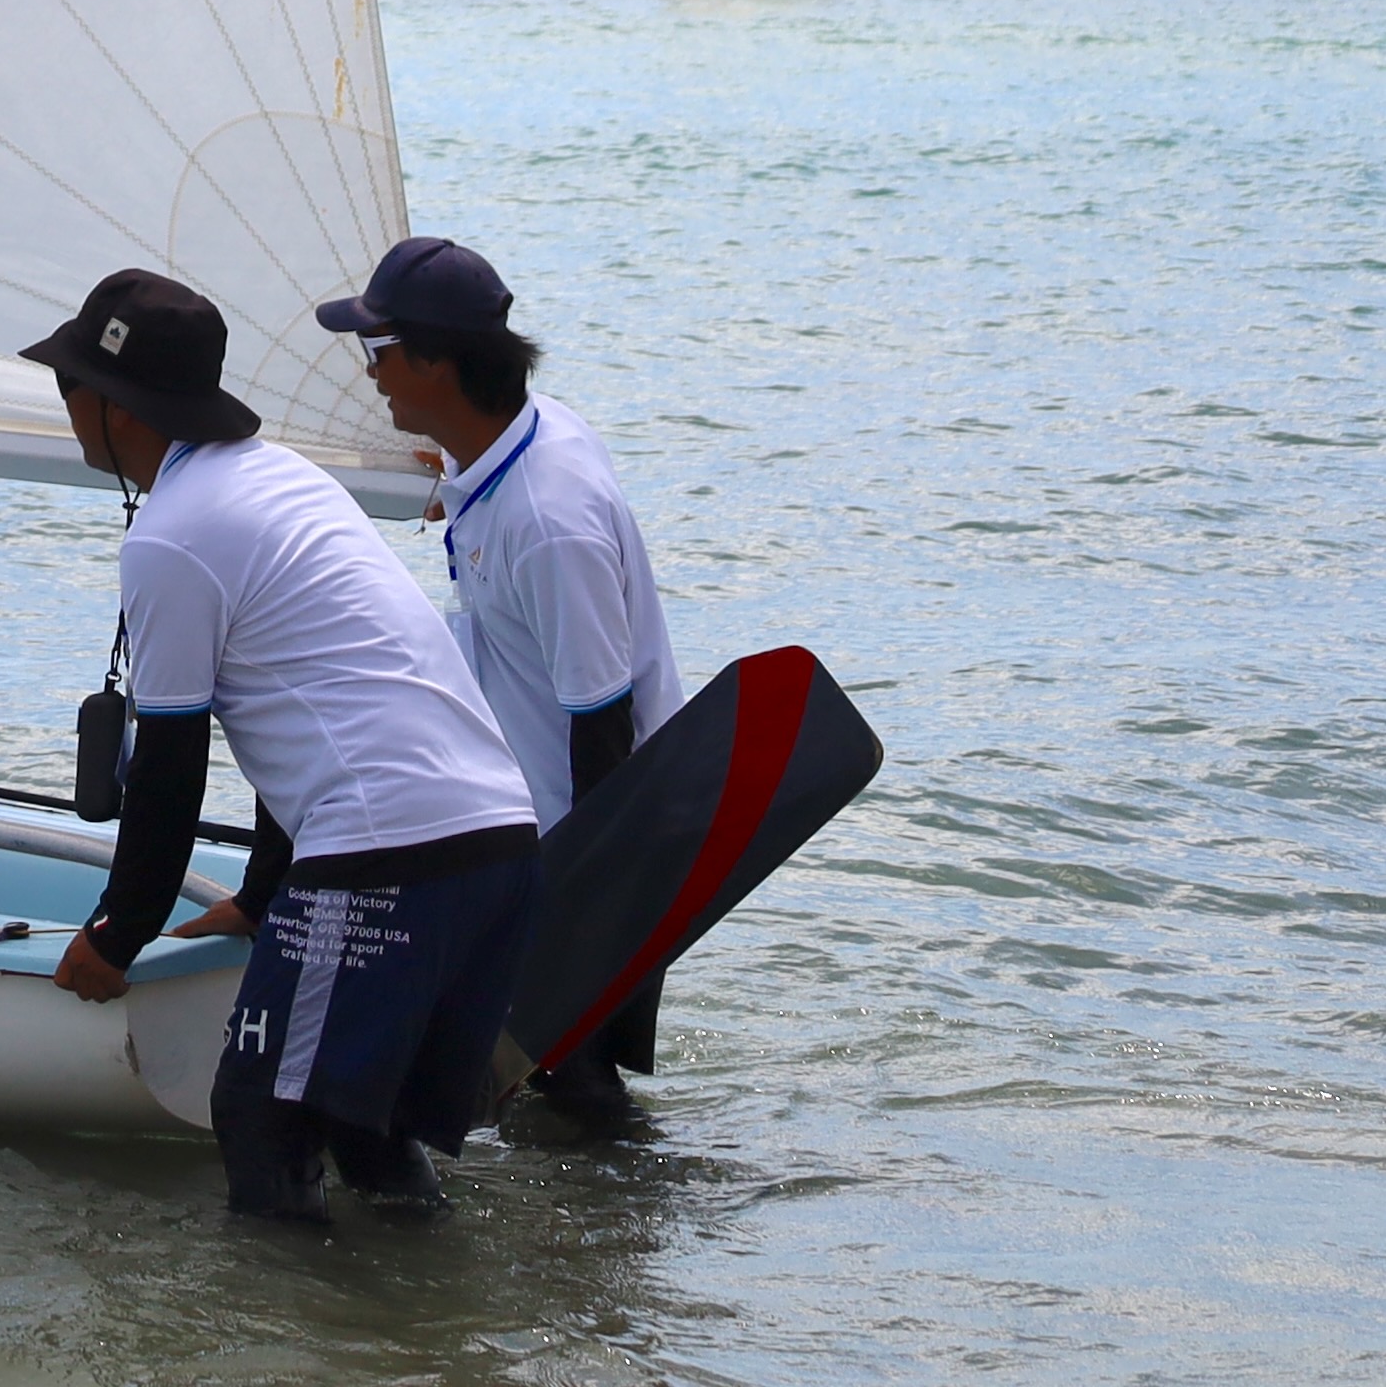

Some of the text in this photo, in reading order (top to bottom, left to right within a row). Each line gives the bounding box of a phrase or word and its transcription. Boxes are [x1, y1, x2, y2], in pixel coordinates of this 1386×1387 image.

[288, 887, 396, 912] Goddess of Victory
[303, 906, 364, 923] MCMLXXII
[276, 929, 384, 955] Designed for sport
[384, 929, 410, 943] USA
[281, 948, 367, 968] crafted for life.
